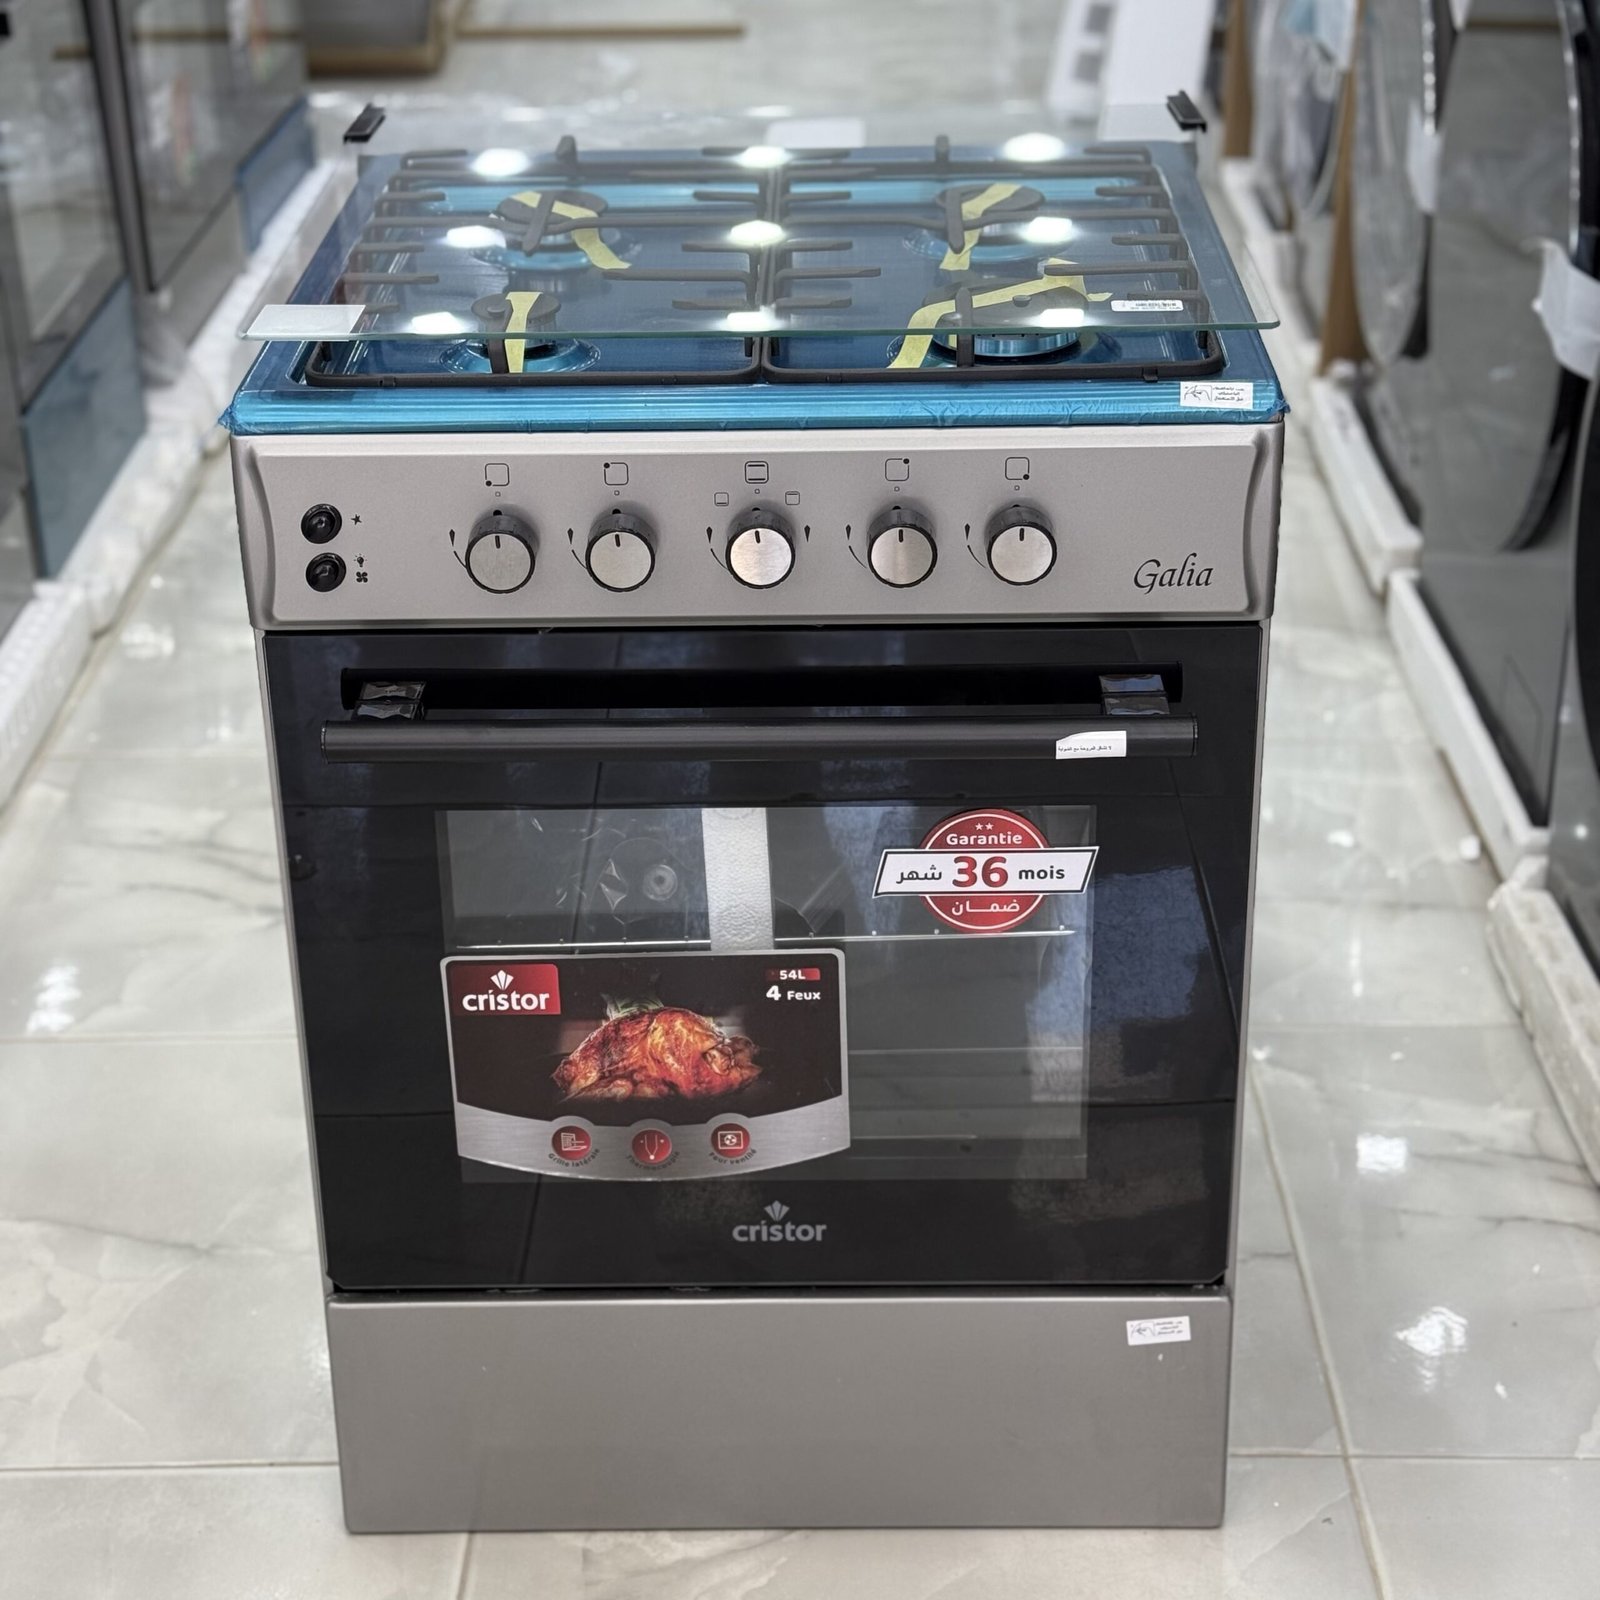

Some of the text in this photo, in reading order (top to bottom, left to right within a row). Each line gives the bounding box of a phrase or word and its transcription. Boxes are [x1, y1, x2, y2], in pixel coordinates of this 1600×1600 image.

[1133, 552, 1214, 595] Galia
[946, 831, 1023, 846] Garantie
[896, 855, 1065, 888] شهر 36 mois
[779, 969, 807, 981] 54L
[765, 985, 821, 1001] 4 Feux
[708, 1151, 728, 1164] Four
